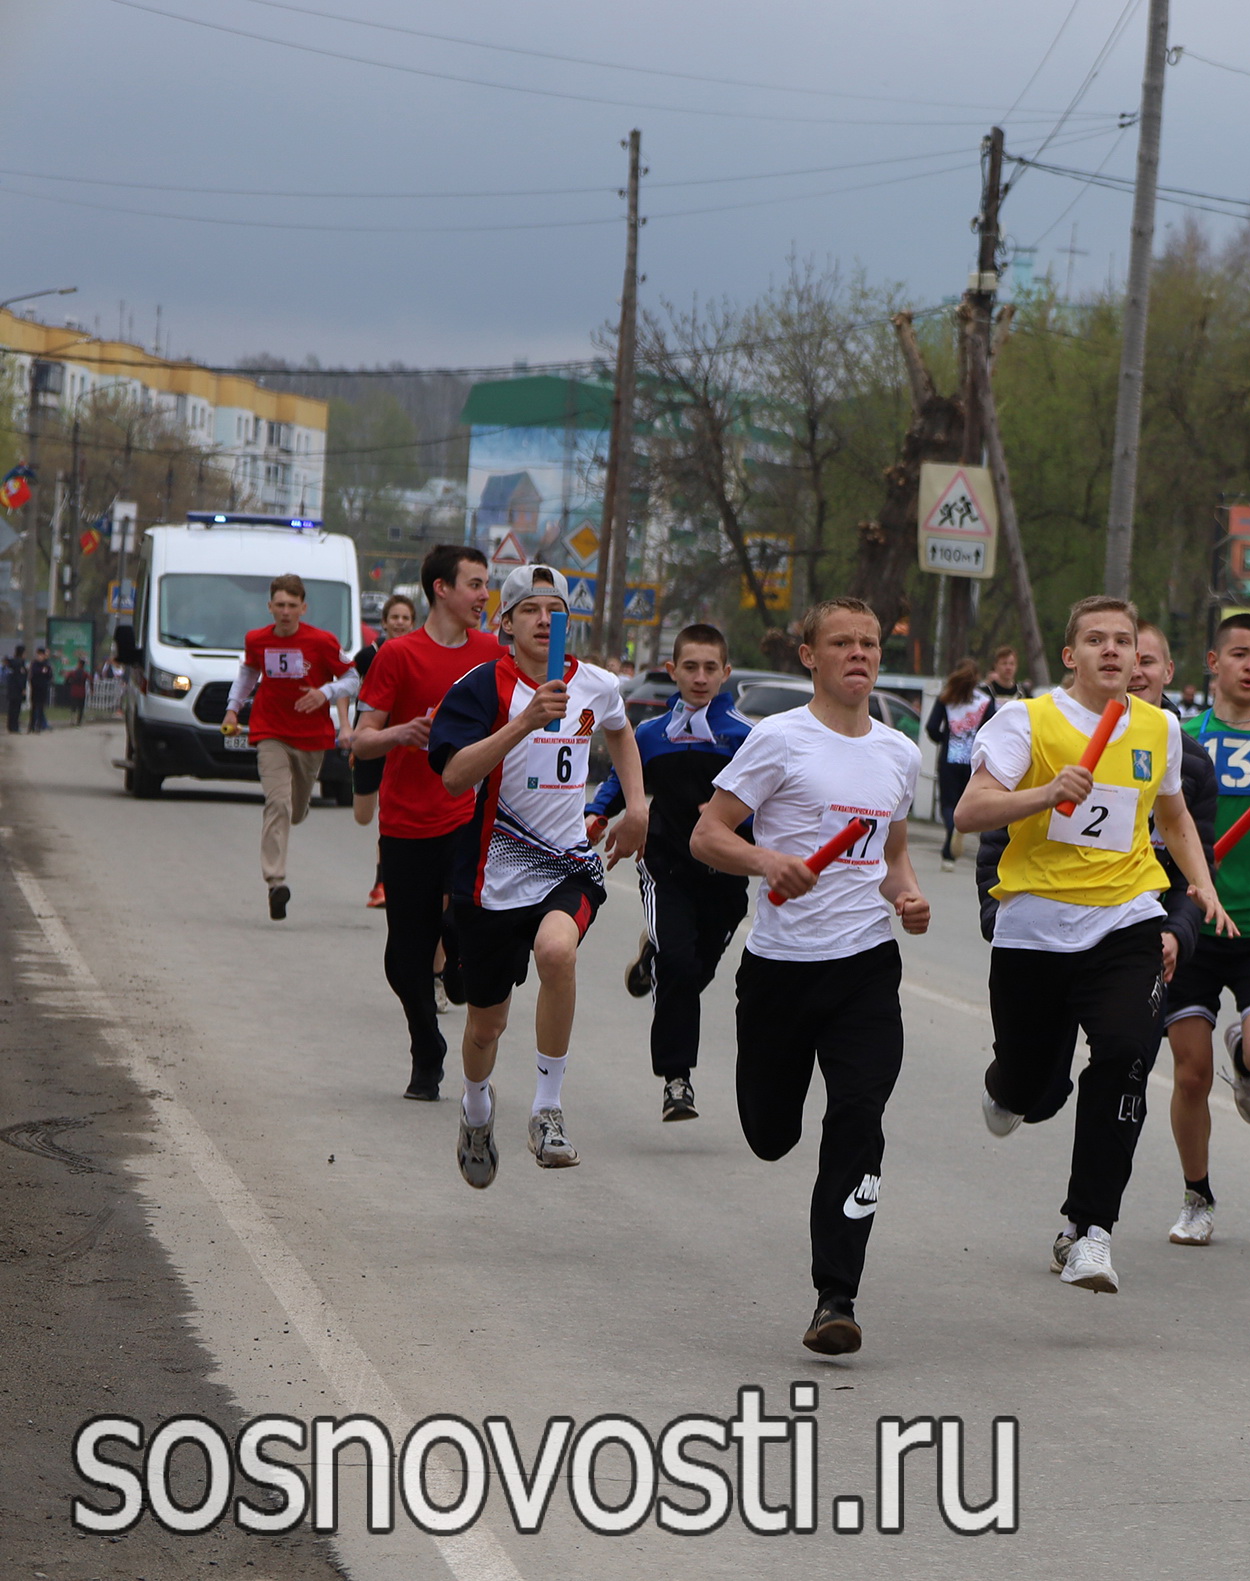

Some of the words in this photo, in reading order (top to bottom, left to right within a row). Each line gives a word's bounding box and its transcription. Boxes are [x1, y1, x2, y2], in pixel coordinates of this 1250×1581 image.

[279, 654, 288, 672] 5
[556, 745, 572, 784] 6
[1080, 805, 1109, 838] 2
